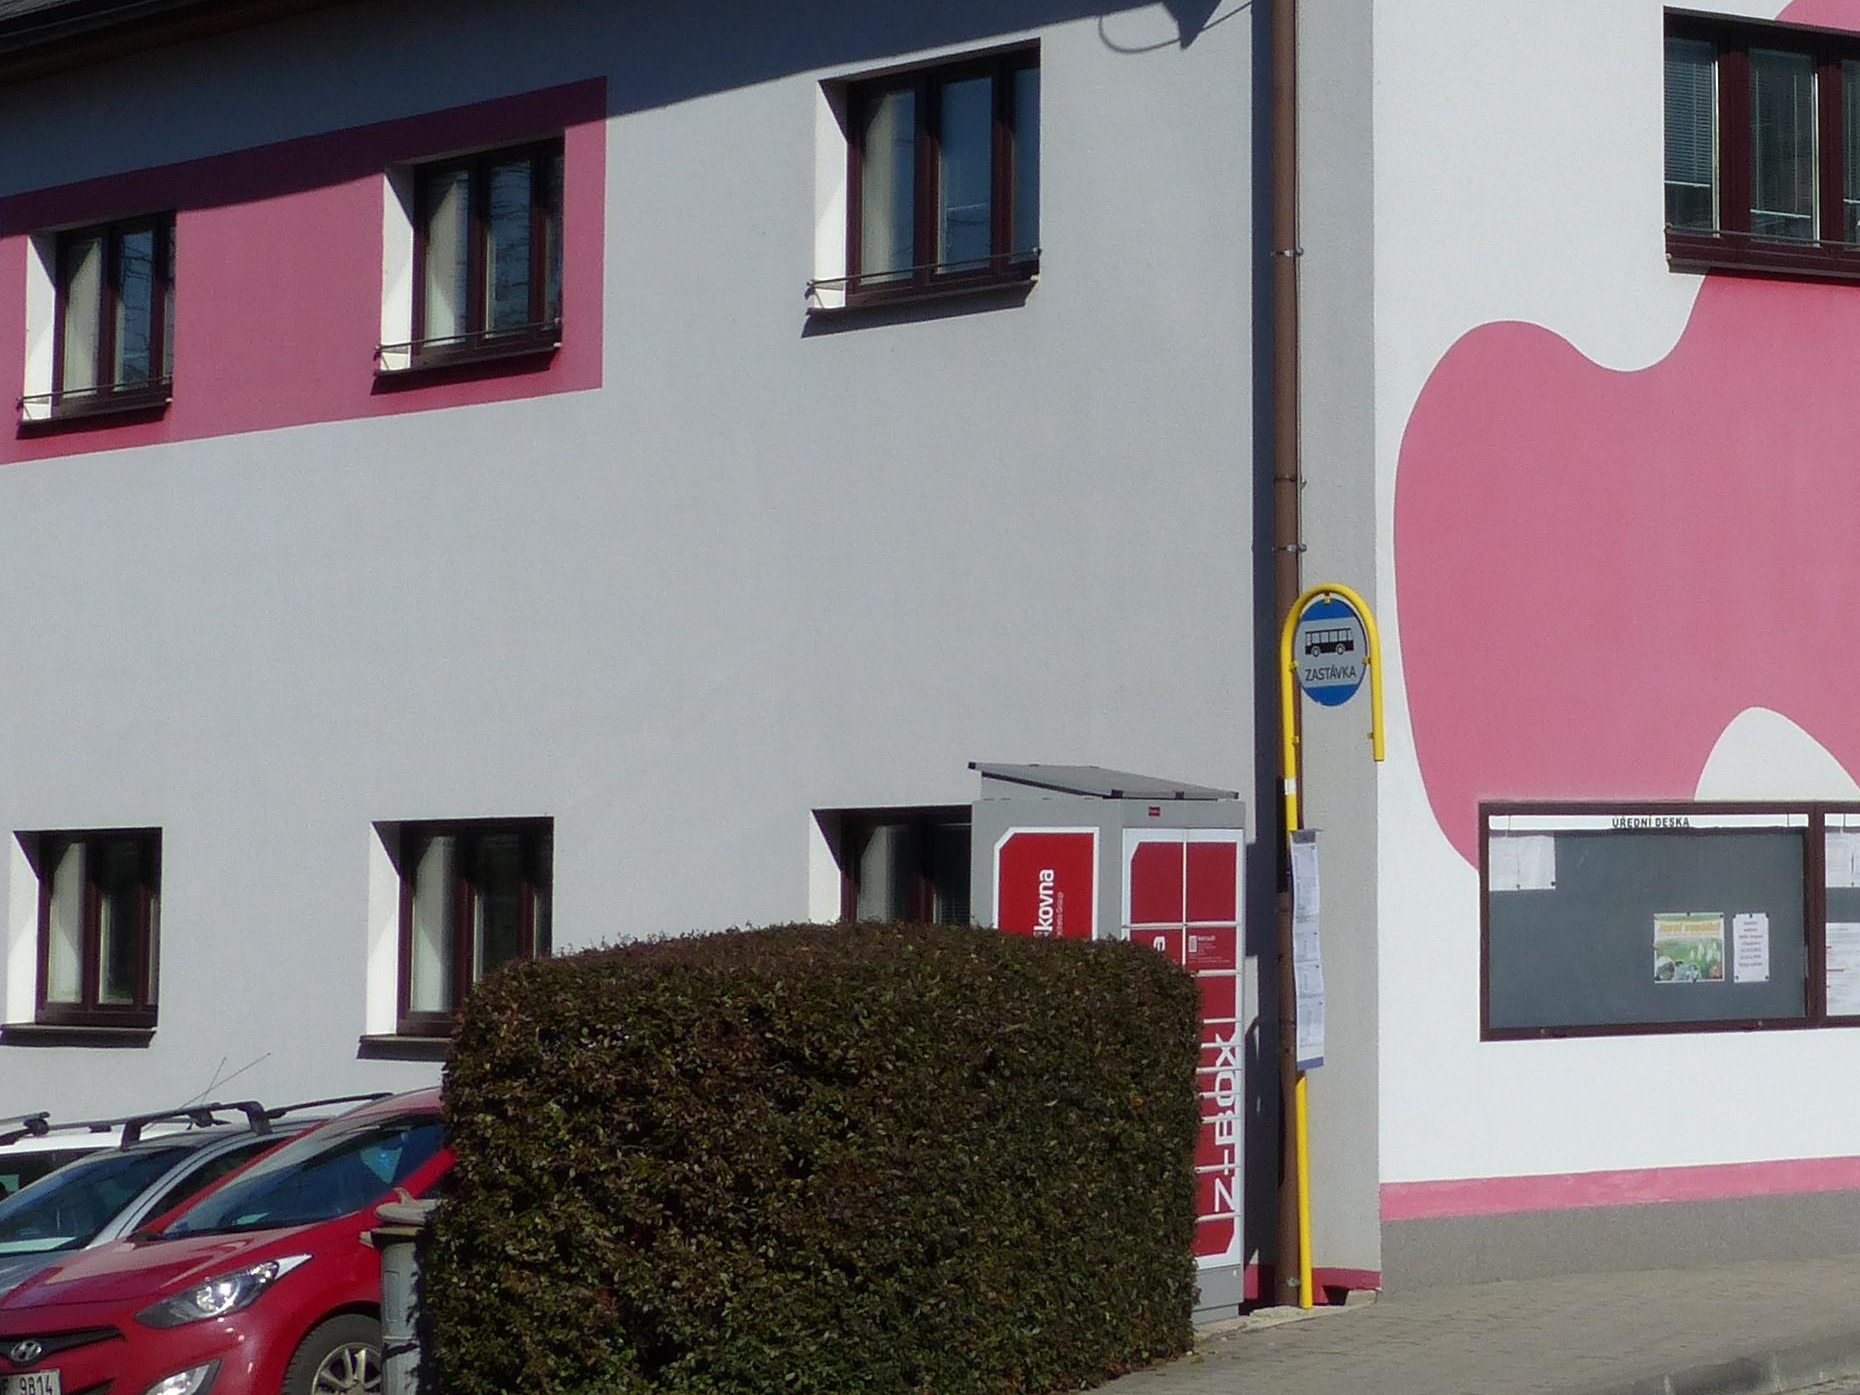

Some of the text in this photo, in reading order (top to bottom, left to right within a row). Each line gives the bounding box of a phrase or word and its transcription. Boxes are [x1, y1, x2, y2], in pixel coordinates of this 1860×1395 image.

[1305, 664, 1356, 681] ZASTÁVKA
[1655, 816, 1690, 828] DESKA
[19, 1374, 54, 1395] 9814
